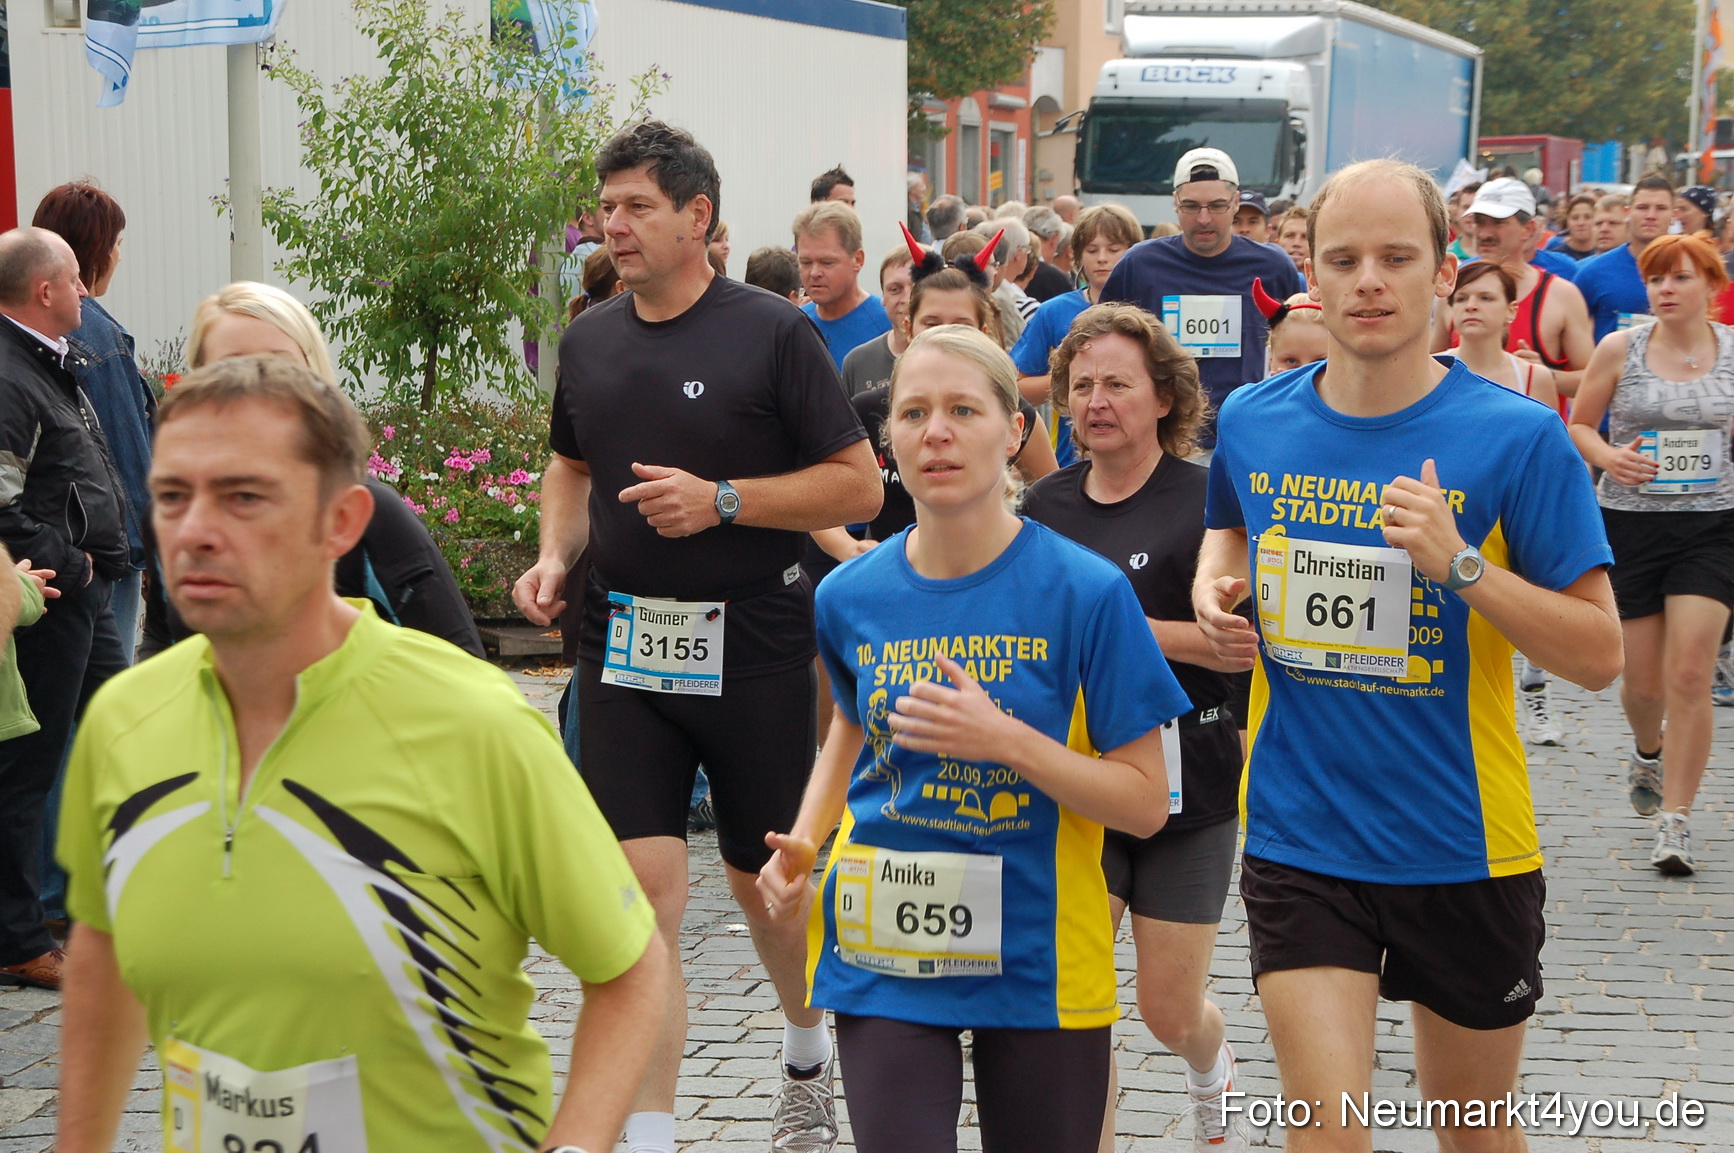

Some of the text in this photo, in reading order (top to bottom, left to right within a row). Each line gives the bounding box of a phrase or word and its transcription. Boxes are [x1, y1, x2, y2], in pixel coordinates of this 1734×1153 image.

[1141, 65, 1238, 83] BOCK
[1185, 318, 1230, 335] 6001
[1662, 437, 1699, 449] Andrea
[1664, 454, 1712, 472] 3079
[1249, 472, 1466, 514] 10. NEUMAR
[1271, 498, 1387, 531] STADTLA
[1293, 549, 1386, 582] Christian
[1261, 583, 1269, 601] D
[639, 606, 689, 626] Gunner
[1305, 592, 1377, 631] 661
[615, 625, 622, 638] D
[639, 632, 709, 661] 3155
[857, 634, 1048, 667] 10. NEUMARKTER
[873, 659, 1013, 687] STADTAUF
[1343, 653, 1404, 668] PFLEIDERER
[674, 679, 720, 689] PFLEIDERER
[937, 760, 1025, 788] 20.09.200
[901, 813, 1031, 837] www.stadtlauf-neumarkt.de
[880, 858, 936, 887] Anika
[843, 893, 853, 912] D
[895, 901, 973, 939] 659
[205, 1070, 294, 1118] Markus
